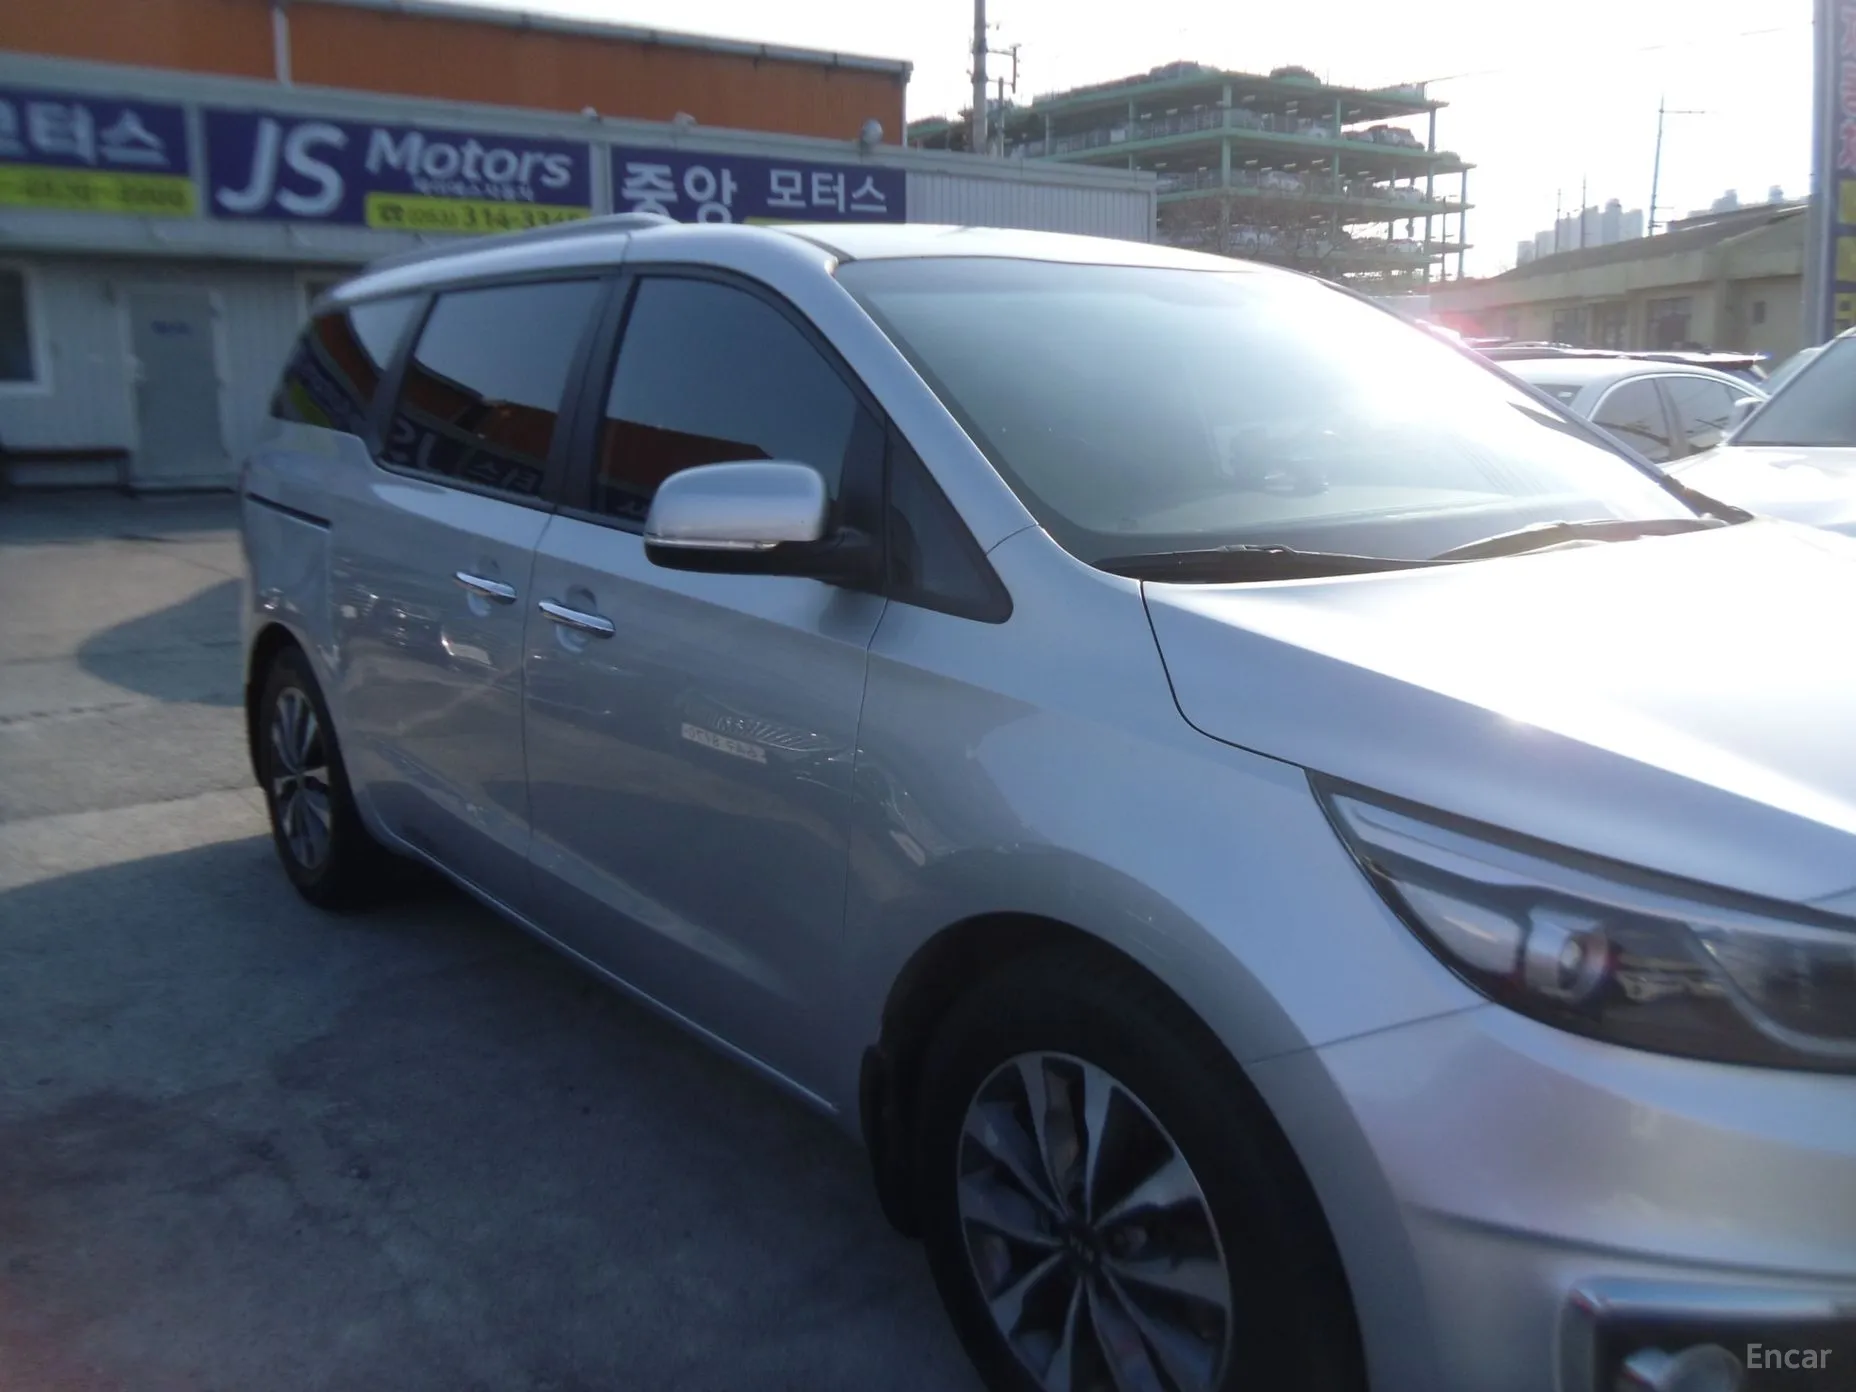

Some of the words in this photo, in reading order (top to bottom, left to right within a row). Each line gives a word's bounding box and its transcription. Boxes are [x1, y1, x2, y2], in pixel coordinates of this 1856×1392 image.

[216, 117, 349, 216] JS
[364, 127, 573, 188] Motors
[621, 161, 737, 223] 중앙
[767, 168, 888, 213] 모터스
